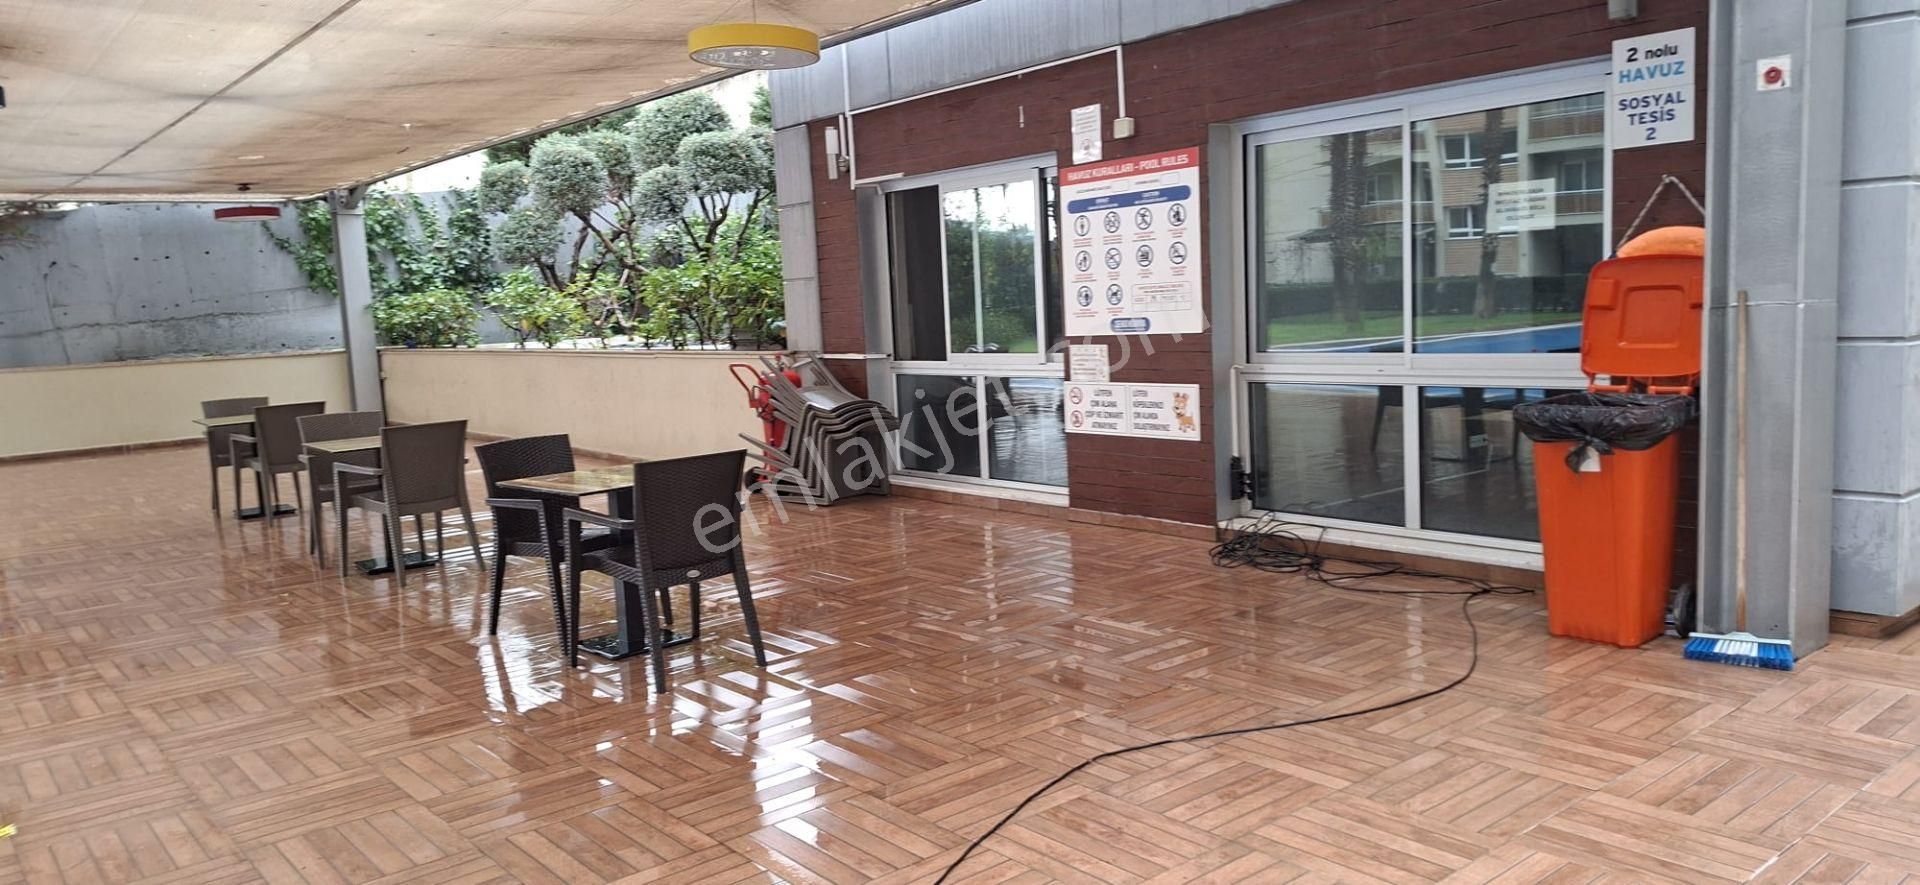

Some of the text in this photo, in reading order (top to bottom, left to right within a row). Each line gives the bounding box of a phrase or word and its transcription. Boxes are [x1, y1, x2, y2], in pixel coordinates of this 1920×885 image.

[1626, 44, 1678, 63] 2 nolu
[1618, 60, 1685, 84] HAVUZ
[1618, 91, 1686, 111] SOSYAL
[1627, 106, 1675, 126] TESİS
[1645, 127, 1656, 141] 2
[1139, 159, 1160, 171] POOL
[1161, 154, 1189, 166] RULES
